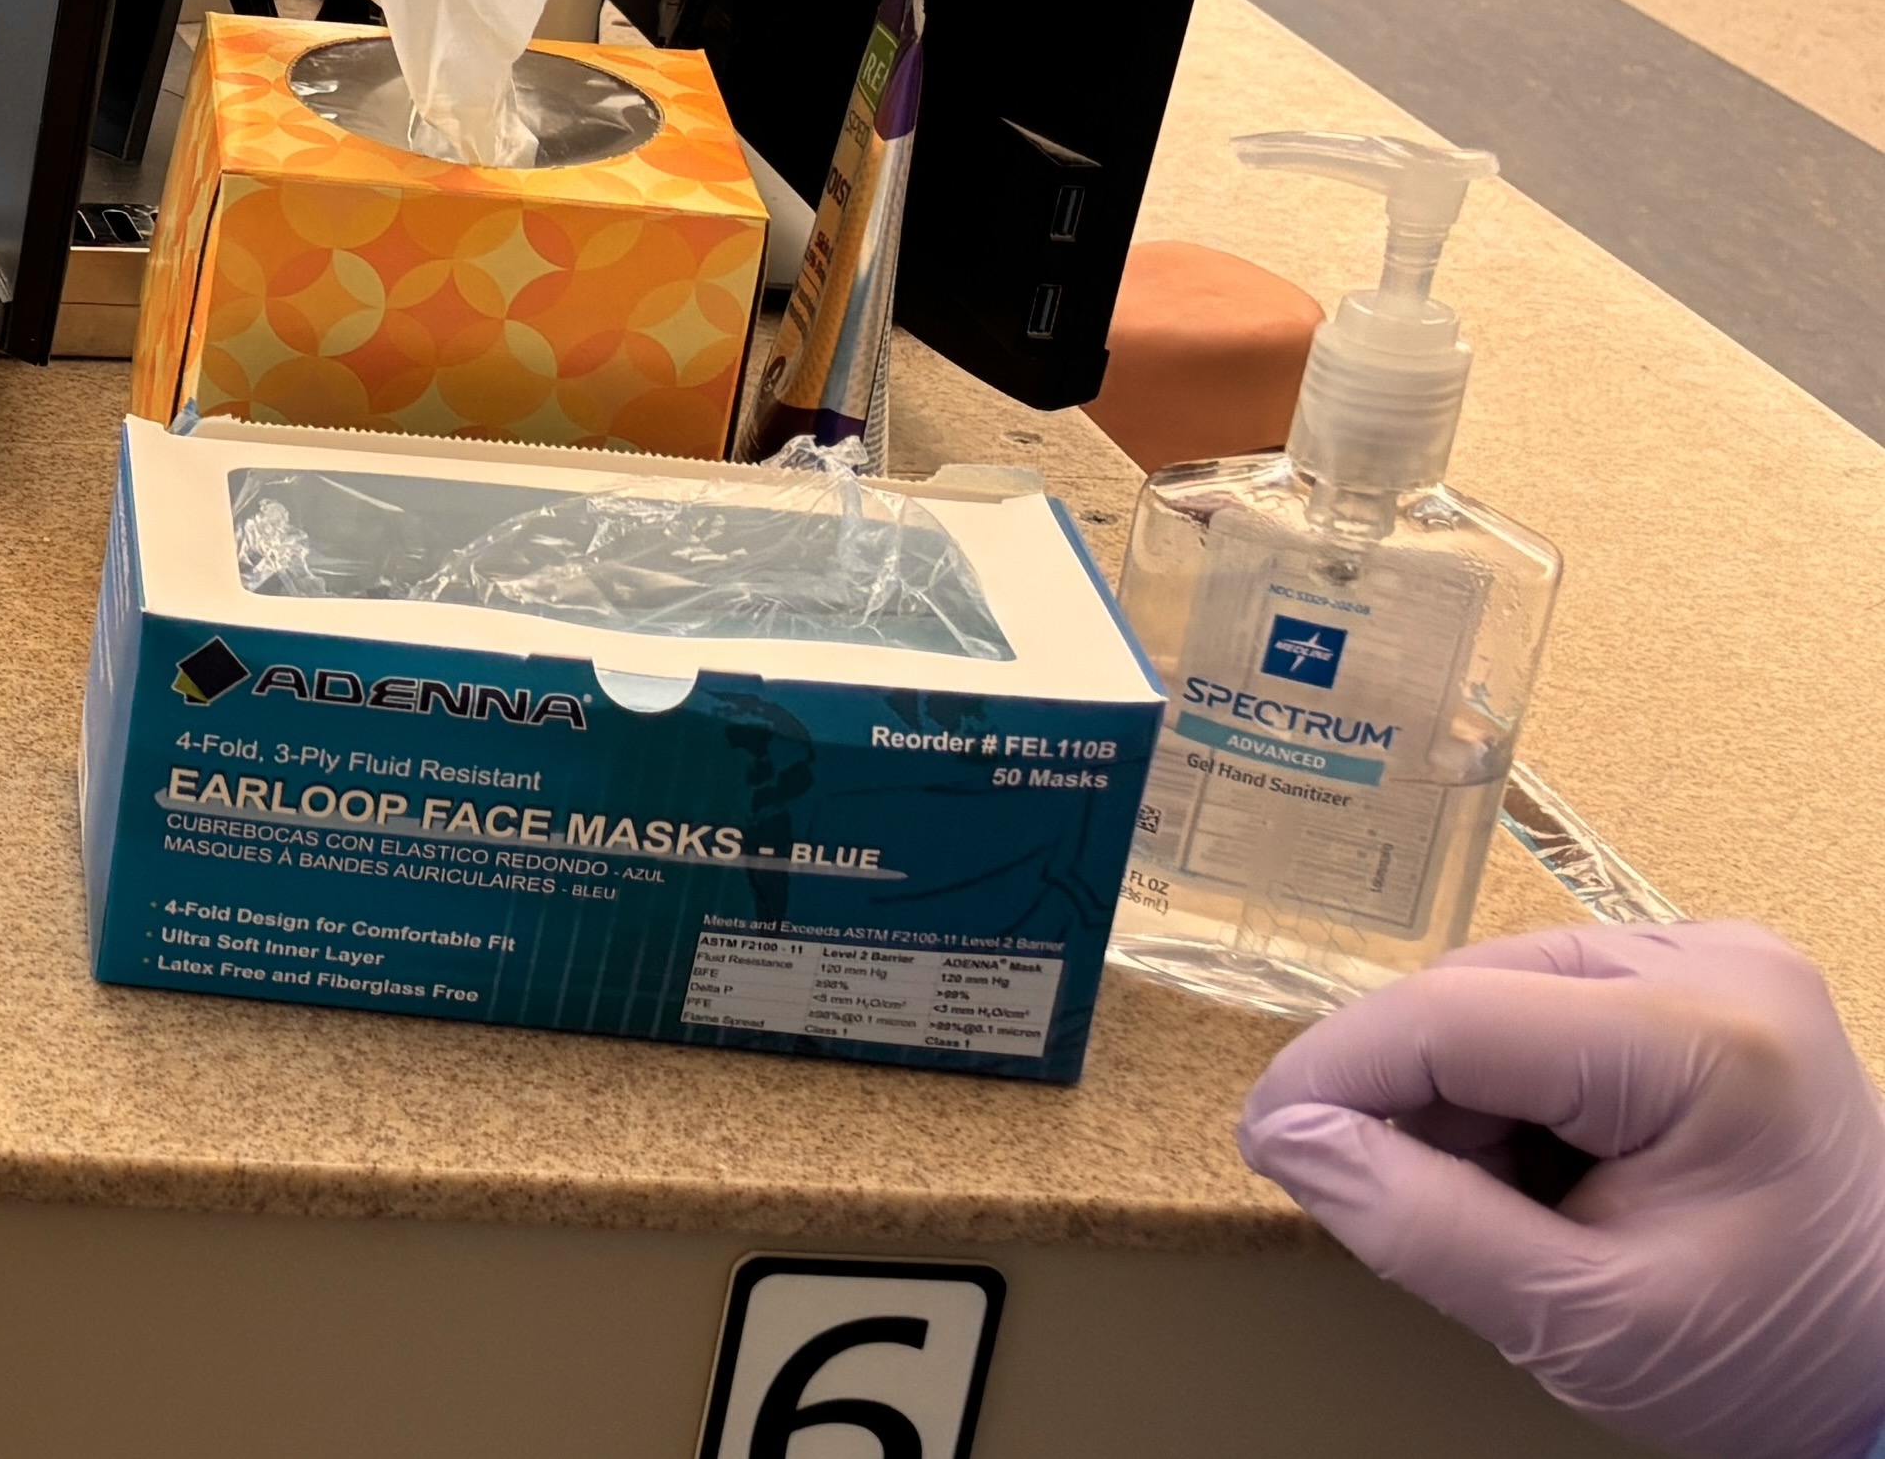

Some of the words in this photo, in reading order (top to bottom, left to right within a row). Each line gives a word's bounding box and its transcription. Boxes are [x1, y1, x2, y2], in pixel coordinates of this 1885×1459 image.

[1274, 640, 1334, 662] MEDLINE
[251, 664, 587, 730] ADENNA
[870, 725, 975, 756] Reorder
[980, 734, 997, 756] #
[1004, 737, 1117, 760] FEL110B
[1226, 733, 1326, 770] ADVANCED
[175, 732, 264, 763] 4-Fold,
[273, 744, 340, 773] 3-Ply
[349, 752, 411, 777] Fluid
[419, 760, 541, 791] Resistant
[992, 767, 1023, 786] 50
[1029, 768, 1109, 789] Masks
[1186, 752, 1214, 774] Gel
[1217, 761, 1267, 790] Hand
[1269, 777, 1353, 808] Sanitizer
[167, 767, 409, 826] EARLOOP
[422, 798, 552, 843] FACE
[566, 814, 744, 860] MASKS
[789, 842, 882, 871] BLUE
[166, 813, 319, 847] CUBREBOCAS
[325, 833, 375, 853] CON
[380, 840, 489, 866] ELASTICO
[495, 851, 608, 878] REDONDO
[621, 868, 665, 883] AZUL
[163, 835, 272, 864] MASQUES
[298, 853, 389, 877] BANDES
[393, 863, 556, 895] AURICULAIRES
[571, 884, 616, 900] BLEU
[1130, 869, 1145, 888] FL
[1148, 878, 1169, 896] OZ
[163, 899, 231, 923] 4-Fold
[236, 907, 310, 933] Design
[316, 915, 346, 935] for
[351, 920, 482, 950] Comfortable
[487, 934, 516, 954] Fit
[703, 914, 746, 929] Meets
[749, 920, 777, 931] and
[780, 921, 840, 938] Exceeds
[843, 927, 888, 942] ASTM
[961, 935, 1000, 948] Level
[1002, 937, 1013, 949] 2
[1016, 937, 1065, 952] Barrier
[160, 927, 211, 948] Ultra
[216, 933, 259, 954] Soft
[265, 939, 318, 960] Inner
[325, 945, 385, 968] Layer
[700, 936, 737, 948] ASTM
[741, 940, 778, 952] F2100
[790, 944, 804, 954] 11
[823, 947, 857, 959] Level
[859, 951, 869, 961] 2
[871, 952, 915, 965] Barrier
[693, 967, 719, 978] BFE
[697, 951, 725, 963] Fluid
[728, 954, 793, 969] Resistance
[820, 963, 841, 974] 120
[844, 967, 867, 975] mm
[870, 968, 888, 980] Hg
[1009, 962, 1043, 973] Mask
[157, 955, 215, 976] Latex
[220, 962, 267, 982] Free
[271, 967, 311, 986] and
[316, 971, 427, 998] Fiberglass
[431, 983, 480, 1004] Free
[690, 982, 720, 994] Delta
[723, 985, 733, 994] P
[941, 973, 962, 984] 120
[992, 977, 1010, 989] Hg
[683, 1011, 719, 1023] Flame
[722, 1016, 765, 1028] Spread
[804, 1025, 837, 1036] Class
[925, 1036, 960, 1048] Class
[748, 1315, 929, 1459] 6
